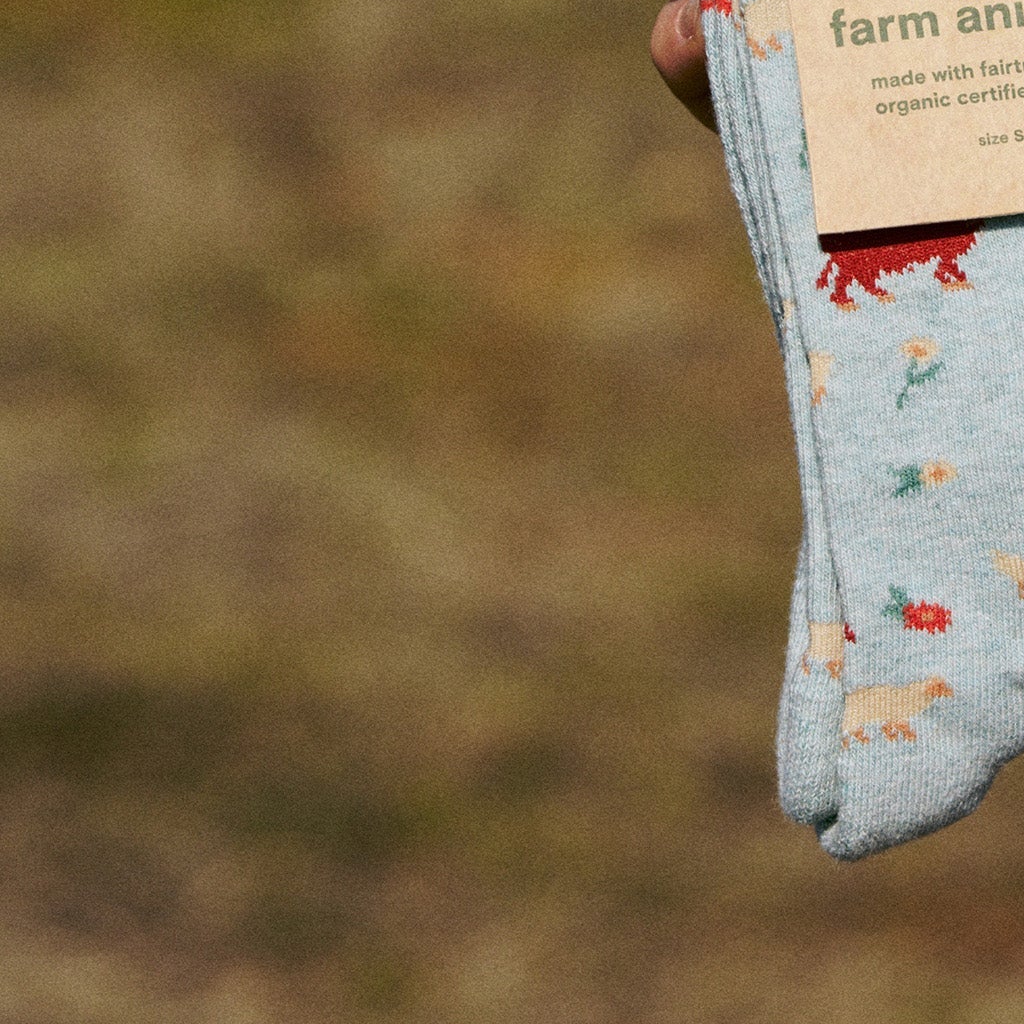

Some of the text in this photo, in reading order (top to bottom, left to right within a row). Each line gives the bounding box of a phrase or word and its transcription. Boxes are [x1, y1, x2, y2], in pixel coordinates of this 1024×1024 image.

[830, 8, 940, 47] farm
[871, 70, 926, 90] made
[932, 64, 974, 83] with
[875, 92, 951, 116] organic
[978, 129, 1024, 147] size S
